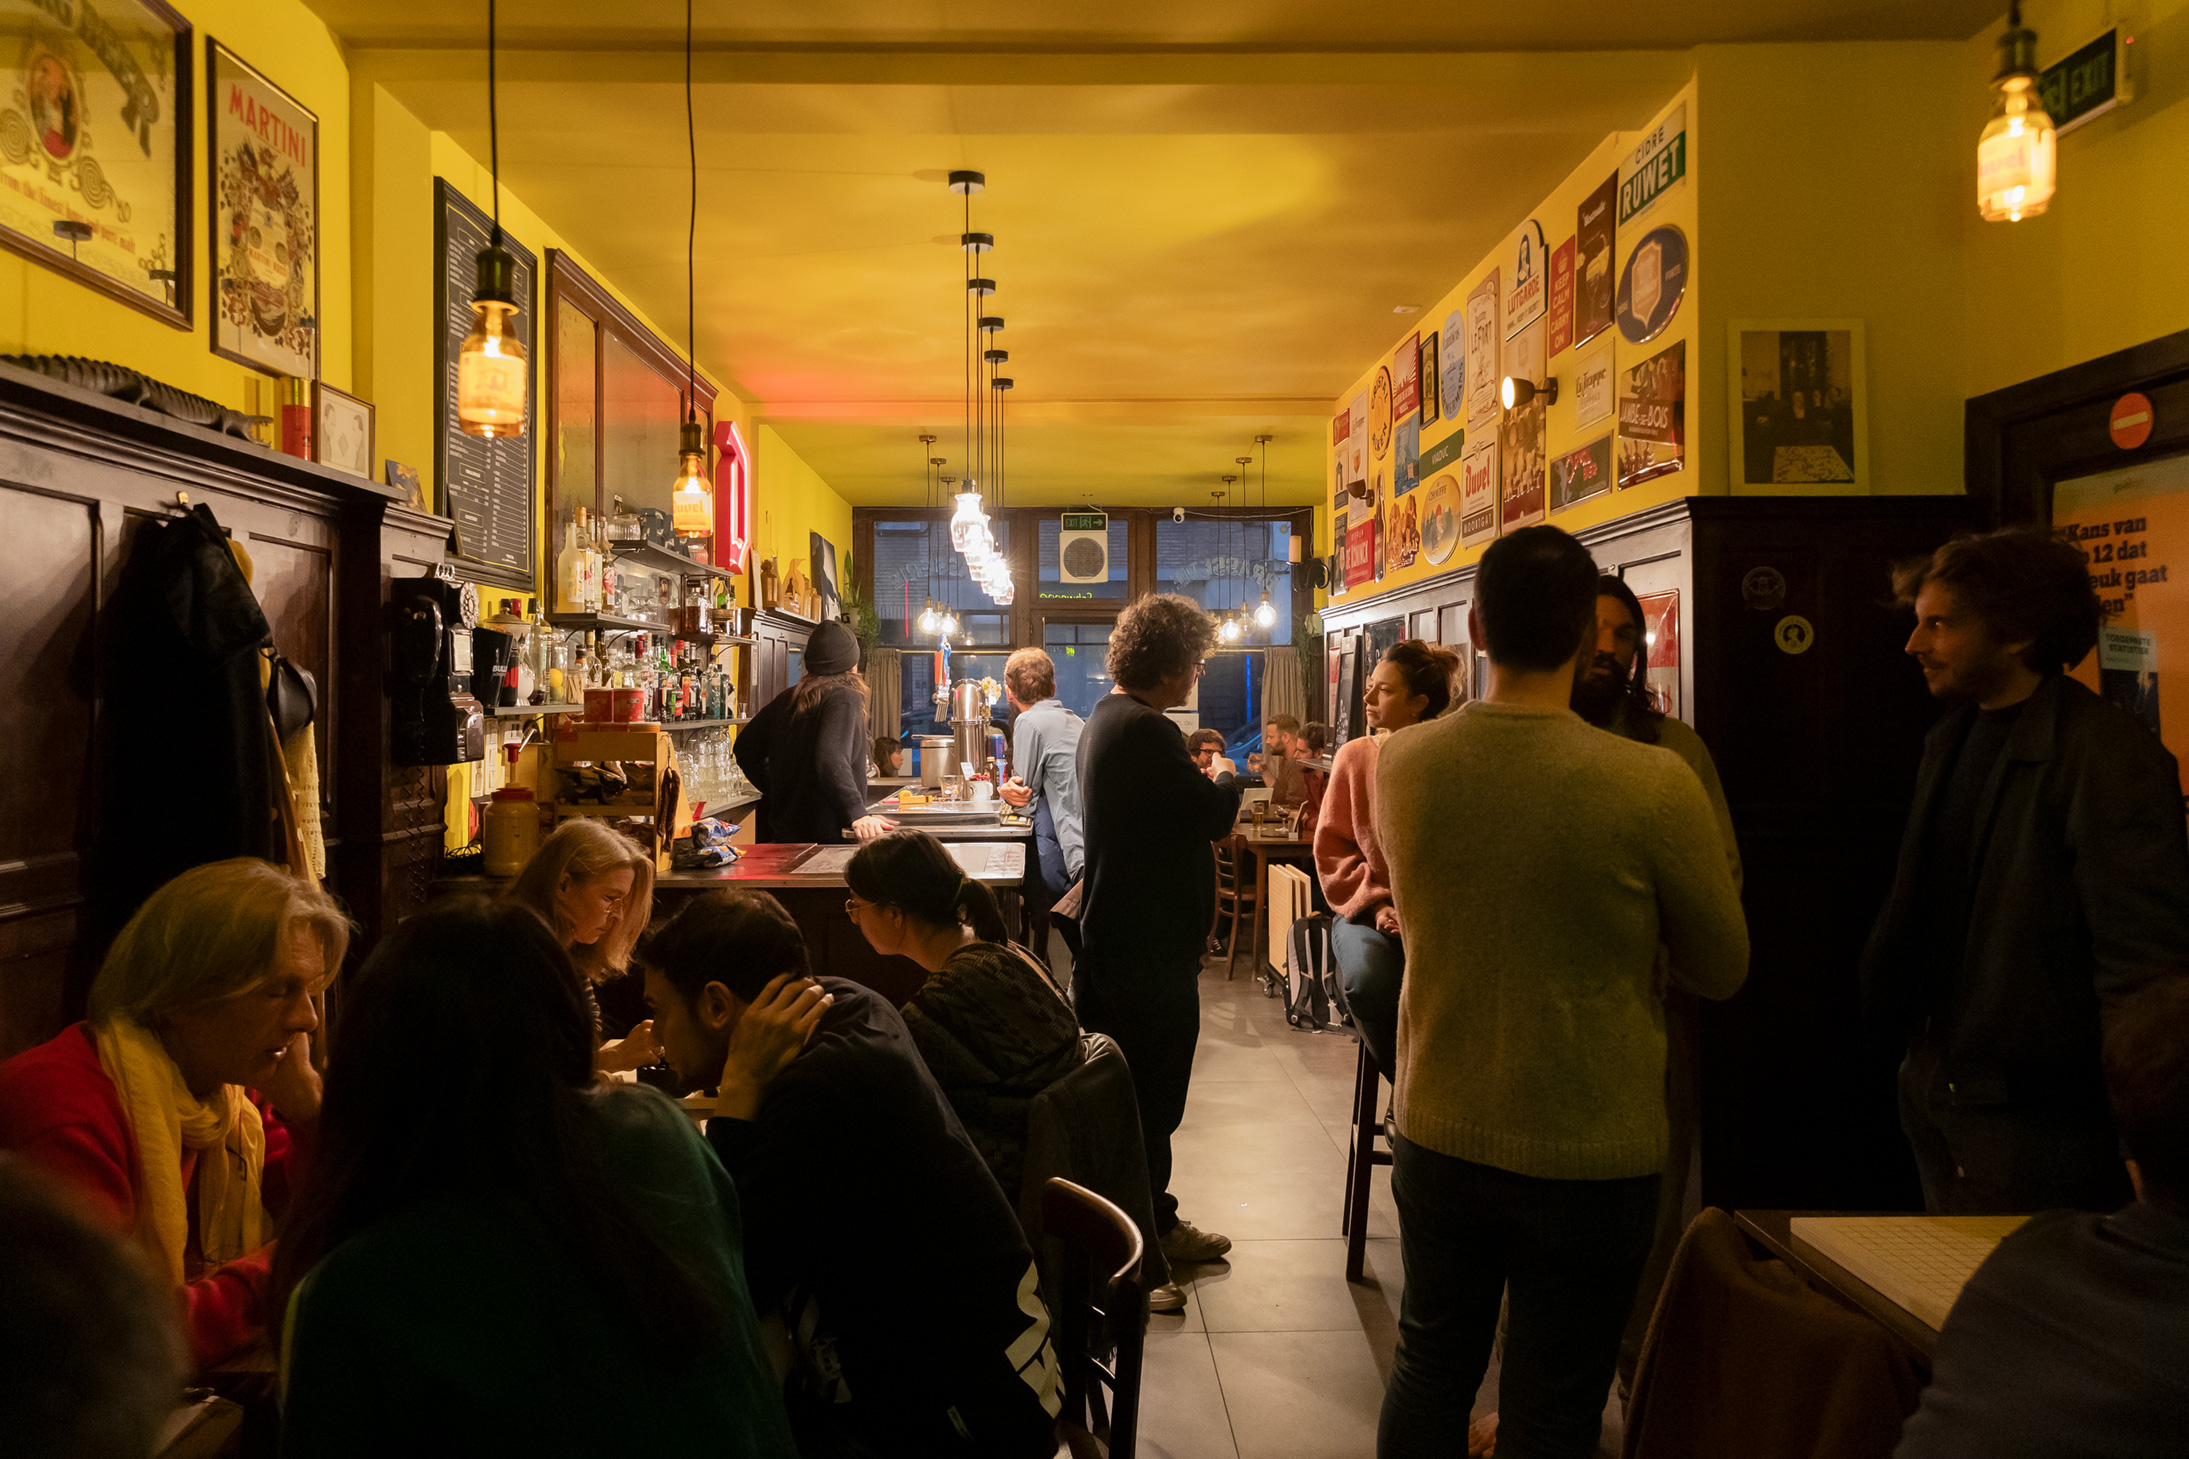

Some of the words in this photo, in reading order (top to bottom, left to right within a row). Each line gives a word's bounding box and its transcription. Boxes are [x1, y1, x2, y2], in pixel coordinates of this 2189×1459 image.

[229, 82, 305, 168] MARTINI
[1635, 126, 1664, 165] CIDRE
[1979, 146, 2024, 177] uvel
[1622, 138, 1680, 219] RUWET
[1507, 274, 1540, 316] LUTGARDE
[1554, 272, 1570, 293] KEEP
[1552, 286, 1570, 310] CALM
[1551, 310, 1571, 335] CARRY
[1554, 332, 1564, 349] ON
[1431, 445, 1449, 465] VIADUC
[1466, 453, 1490, 498] Duvel
[1066, 518, 1078, 528] EXIT
[2113, 517, 2146, 536] van
[2093, 543, 2113, 564] 12
[2116, 540, 2146, 560] dat
[2090, 568, 2122, 589] euk
[2125, 565, 2167, 590] gaat
